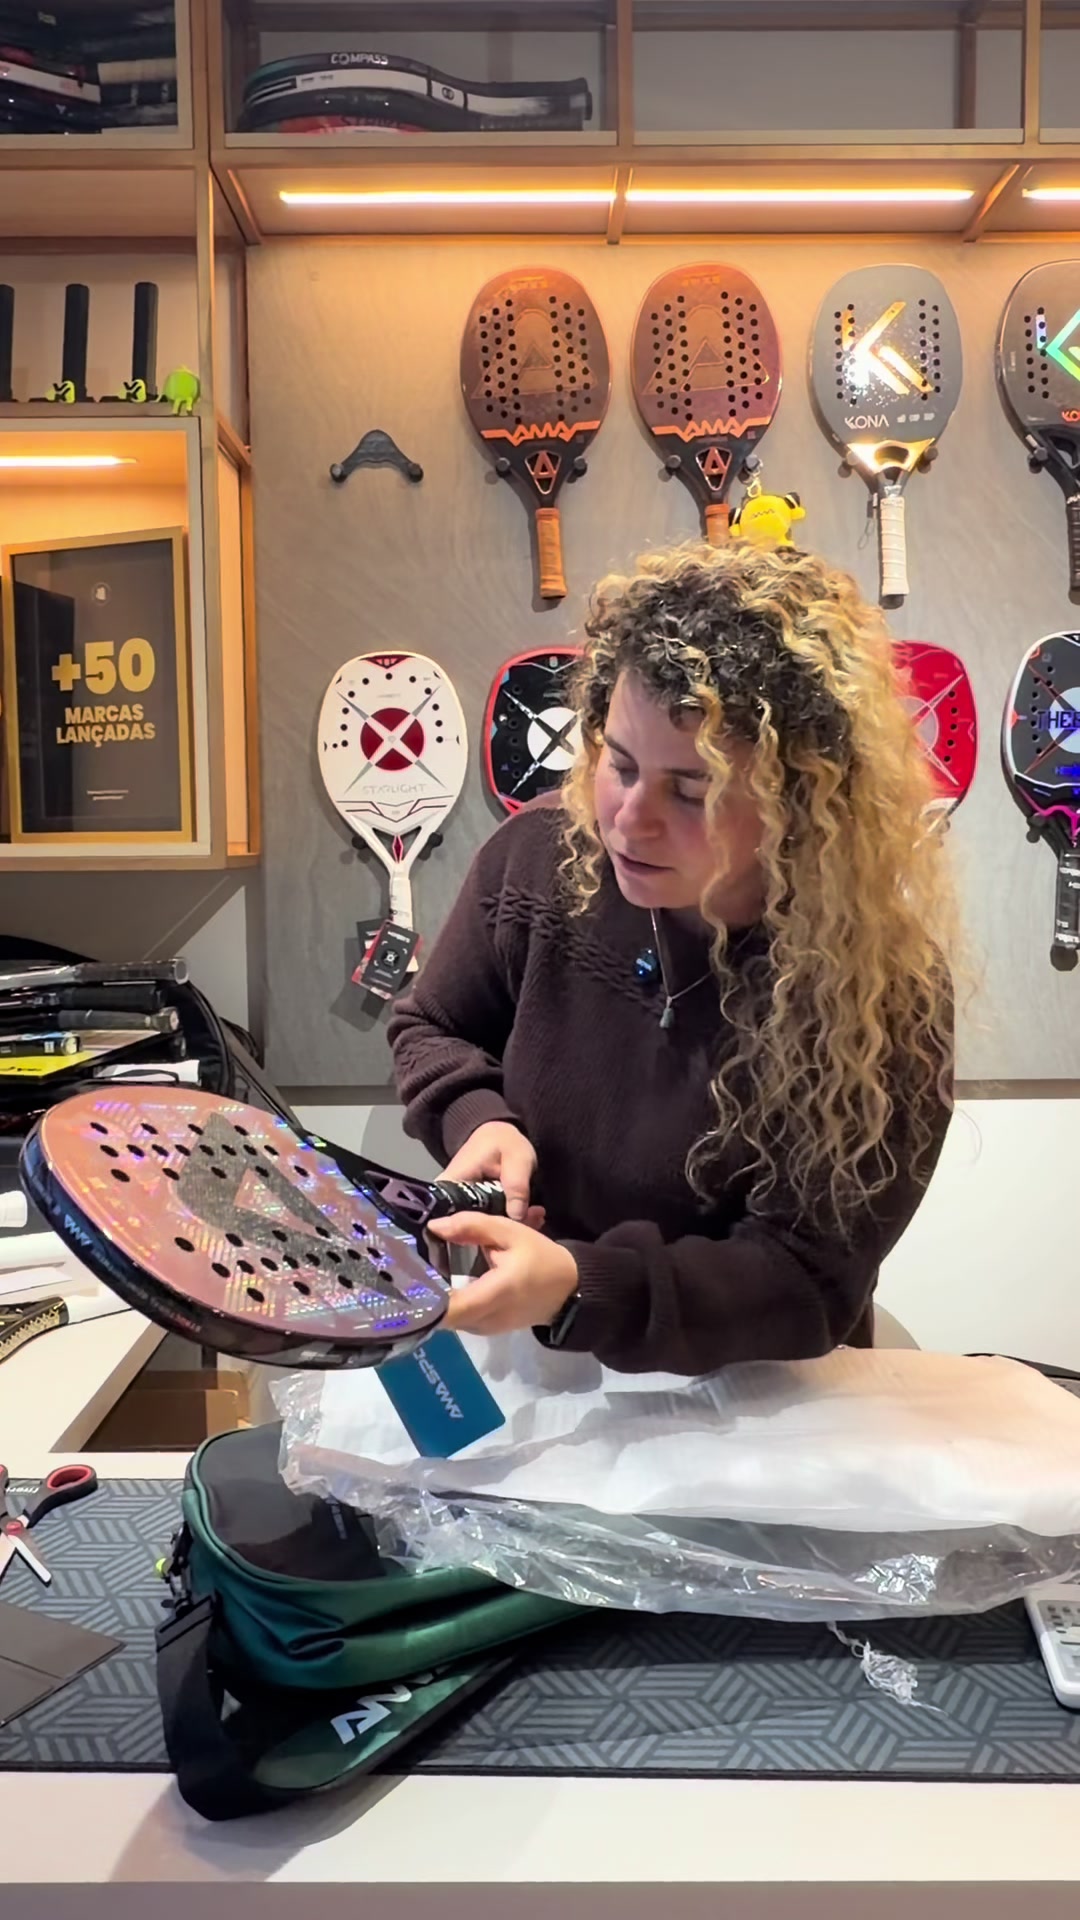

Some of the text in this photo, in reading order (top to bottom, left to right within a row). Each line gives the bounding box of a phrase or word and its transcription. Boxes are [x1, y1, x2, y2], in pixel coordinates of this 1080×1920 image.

[331, 53, 388, 65] COMPASS
[844, 414, 890, 429] KONA
[1061, 410, 1080, 422] KO
[52, 637, 155, 695] +50
[65, 703, 143, 725] MARCAS
[56, 722, 155, 748] LANÇADAS
[363, 783, 427, 794] STARLIGHT
